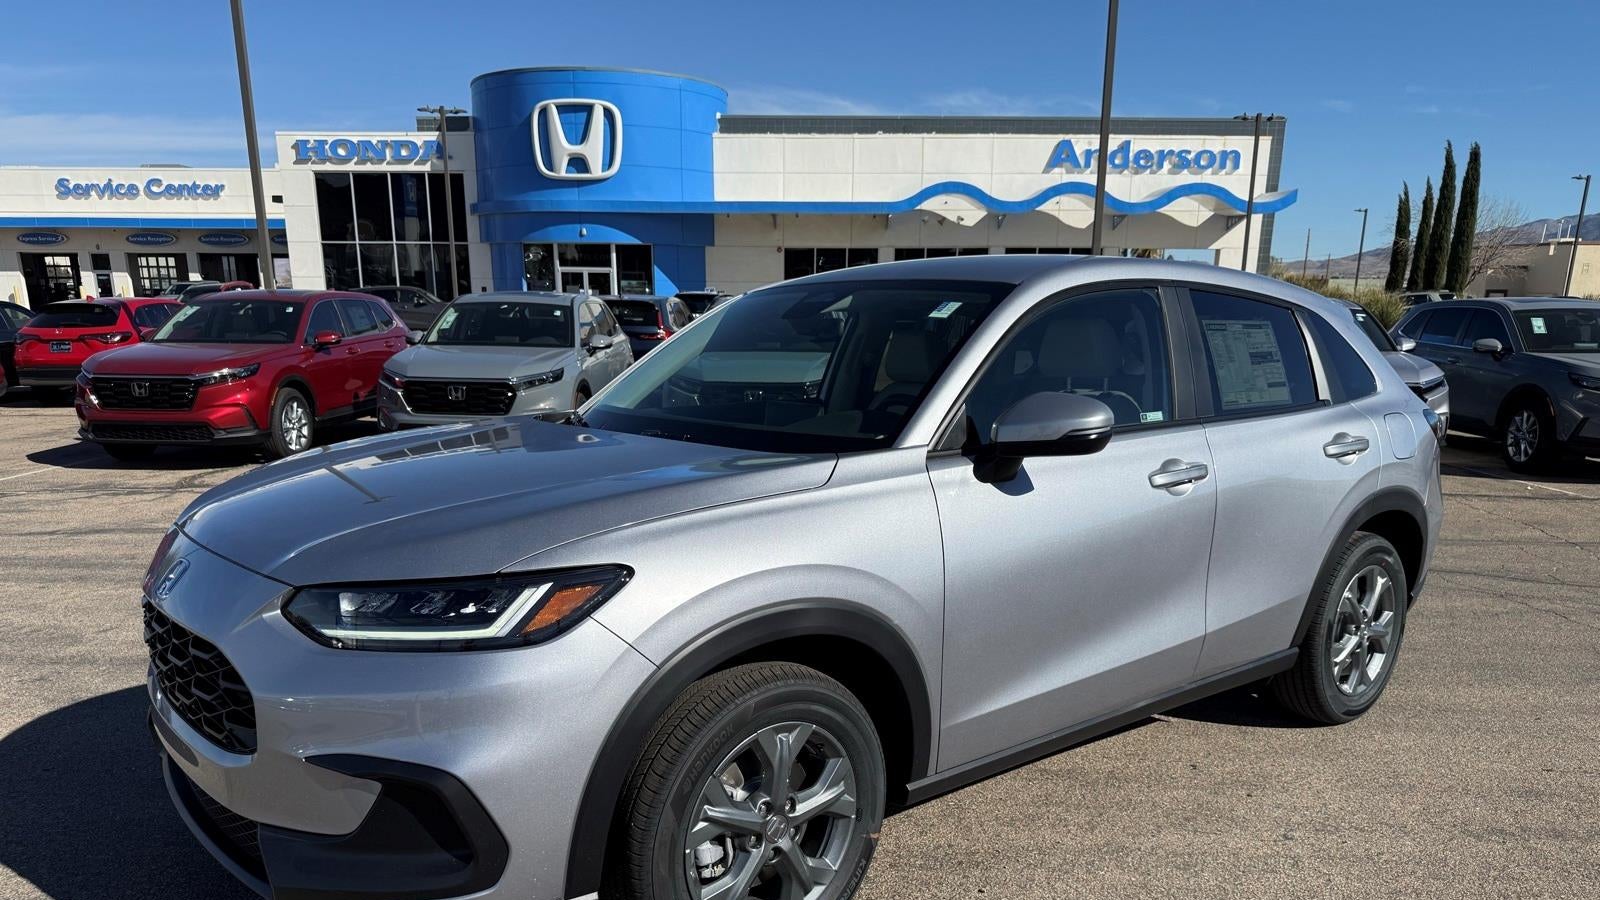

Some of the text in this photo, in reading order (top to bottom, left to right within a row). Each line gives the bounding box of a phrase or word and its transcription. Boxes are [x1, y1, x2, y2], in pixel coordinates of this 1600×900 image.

[293, 138, 452, 163] HONDA
[1044, 138, 1242, 172] Anderson
[56, 178, 225, 199] Service Center
